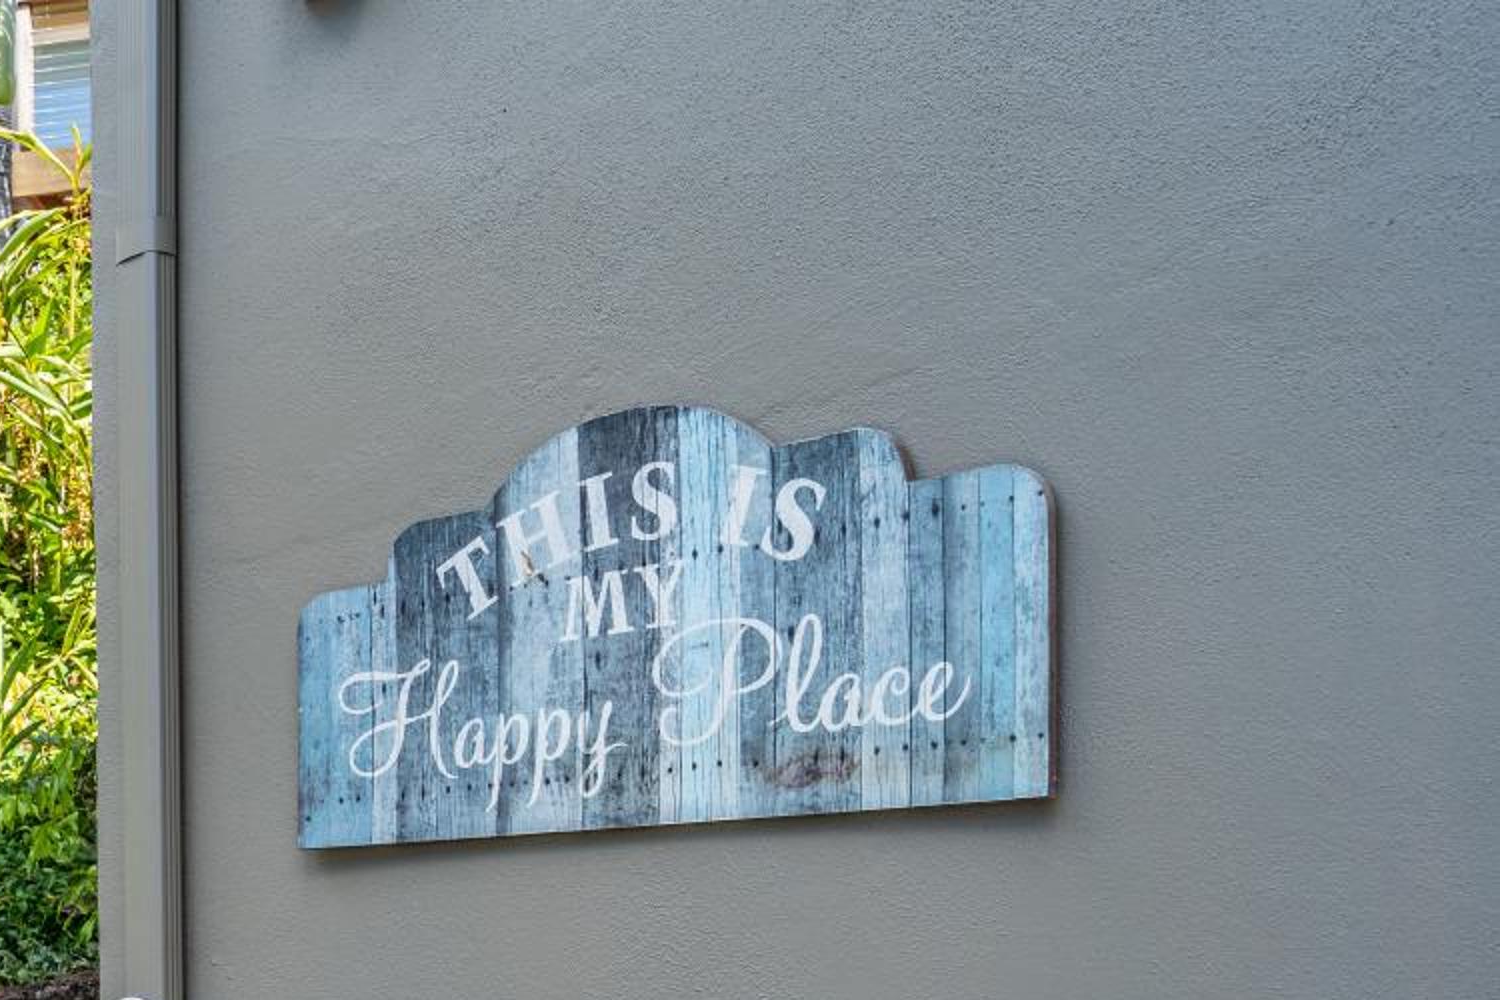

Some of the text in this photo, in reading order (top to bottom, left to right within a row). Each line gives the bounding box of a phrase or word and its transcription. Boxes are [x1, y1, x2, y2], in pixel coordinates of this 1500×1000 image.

[436, 461, 827, 621] THIS IS
[559, 558, 685, 643] MY
[338, 613, 971, 813] Happy Place
